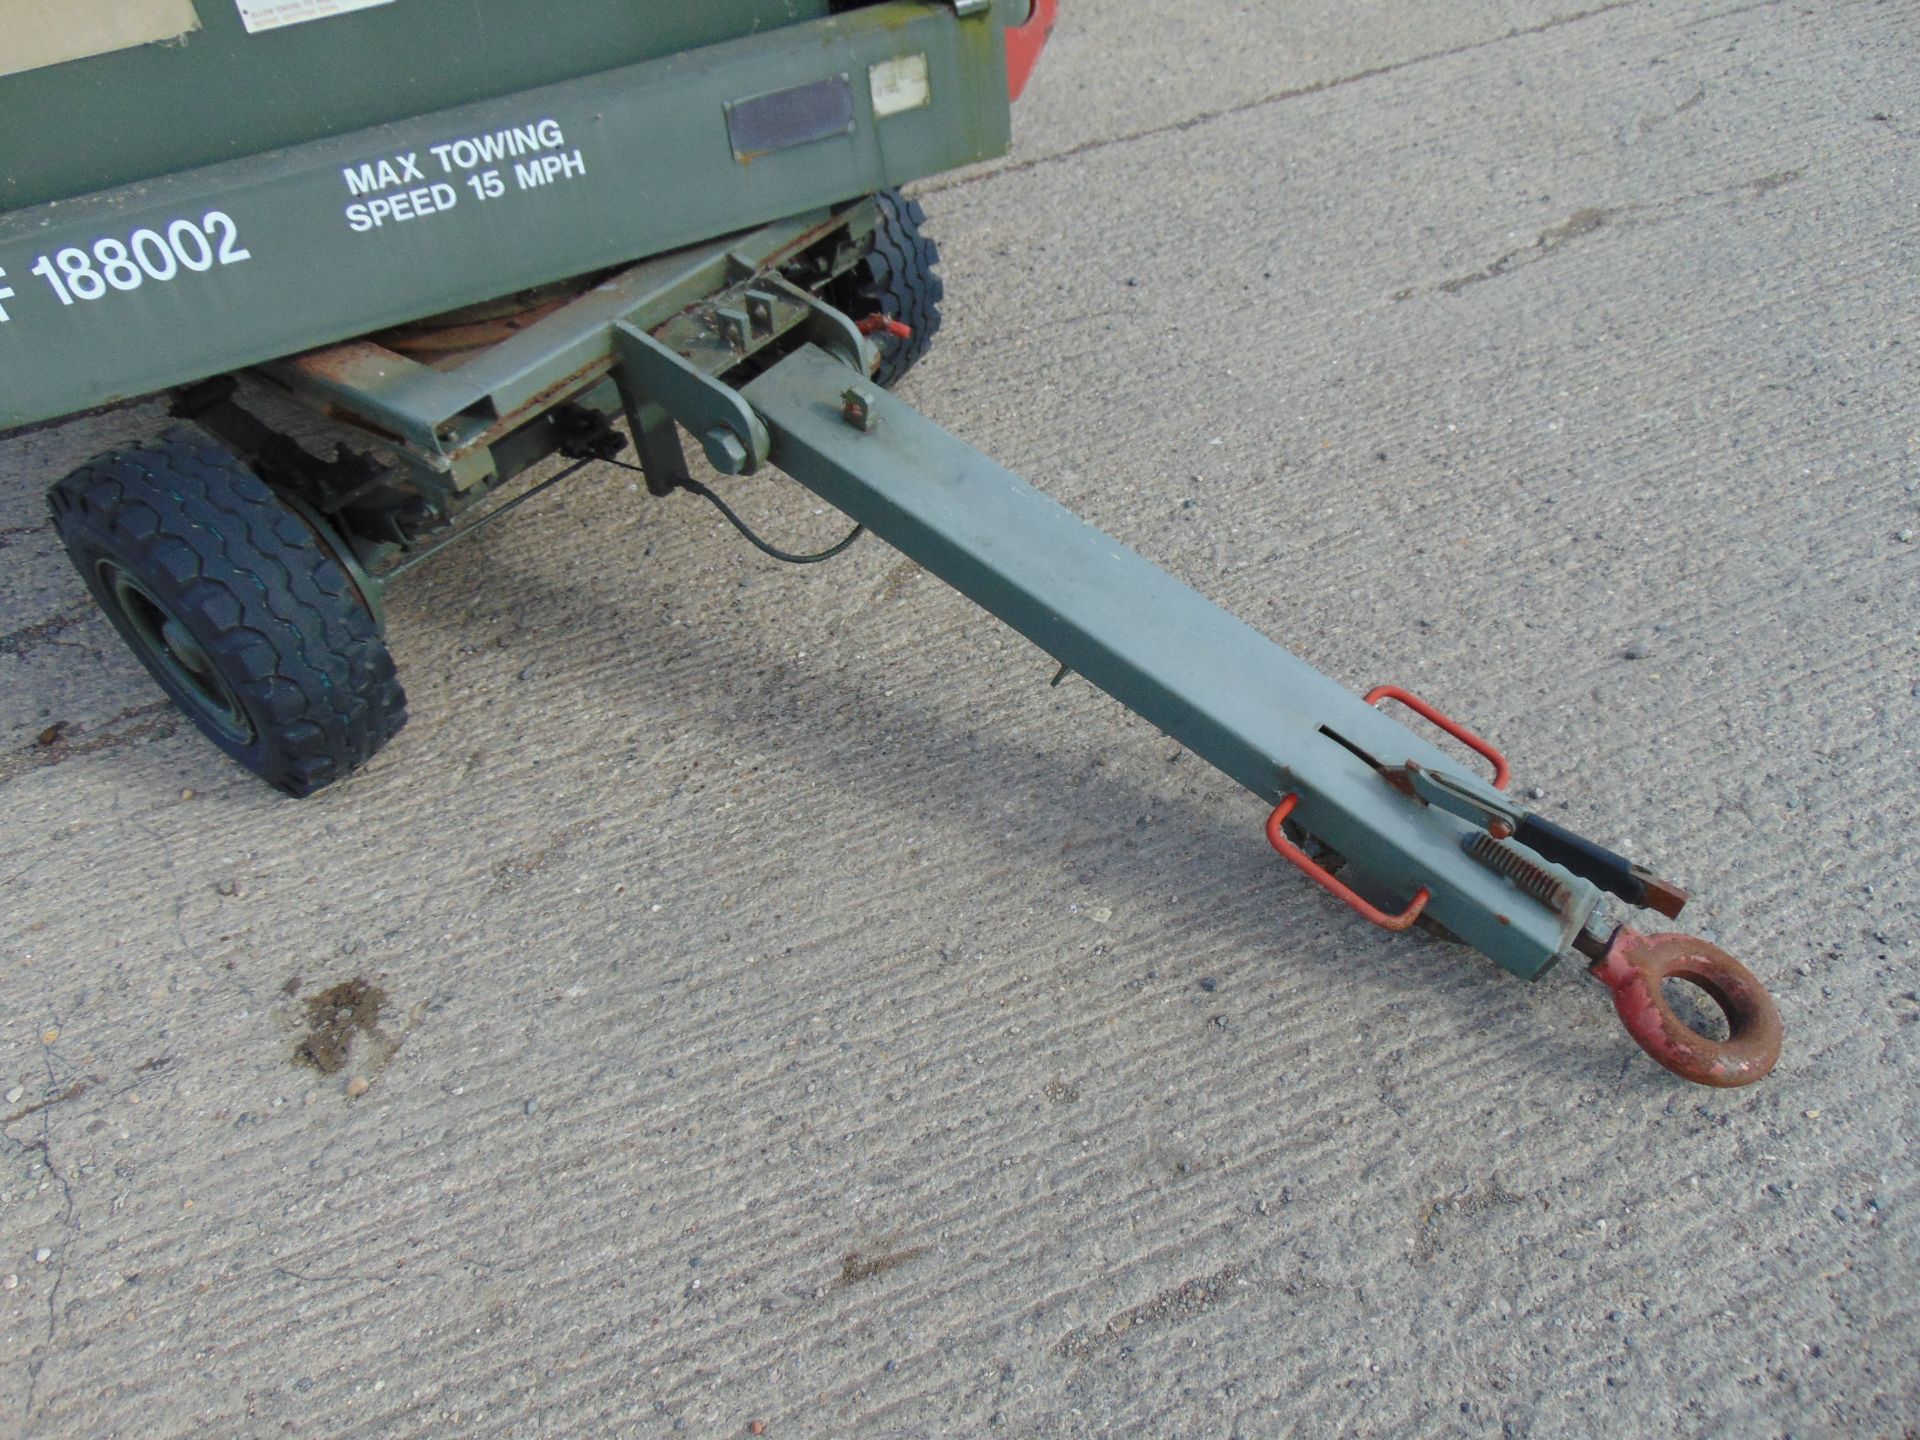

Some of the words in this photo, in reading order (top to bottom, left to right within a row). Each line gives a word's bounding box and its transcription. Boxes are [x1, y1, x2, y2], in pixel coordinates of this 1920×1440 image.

[343, 152, 425, 195] MAX
[430, 119, 565, 173] TOWING
[345, 183, 458, 232] SPEED
[466, 169, 506, 201] 15
[514, 149, 586, 190] MPH
[31, 211, 251, 305] 188002
